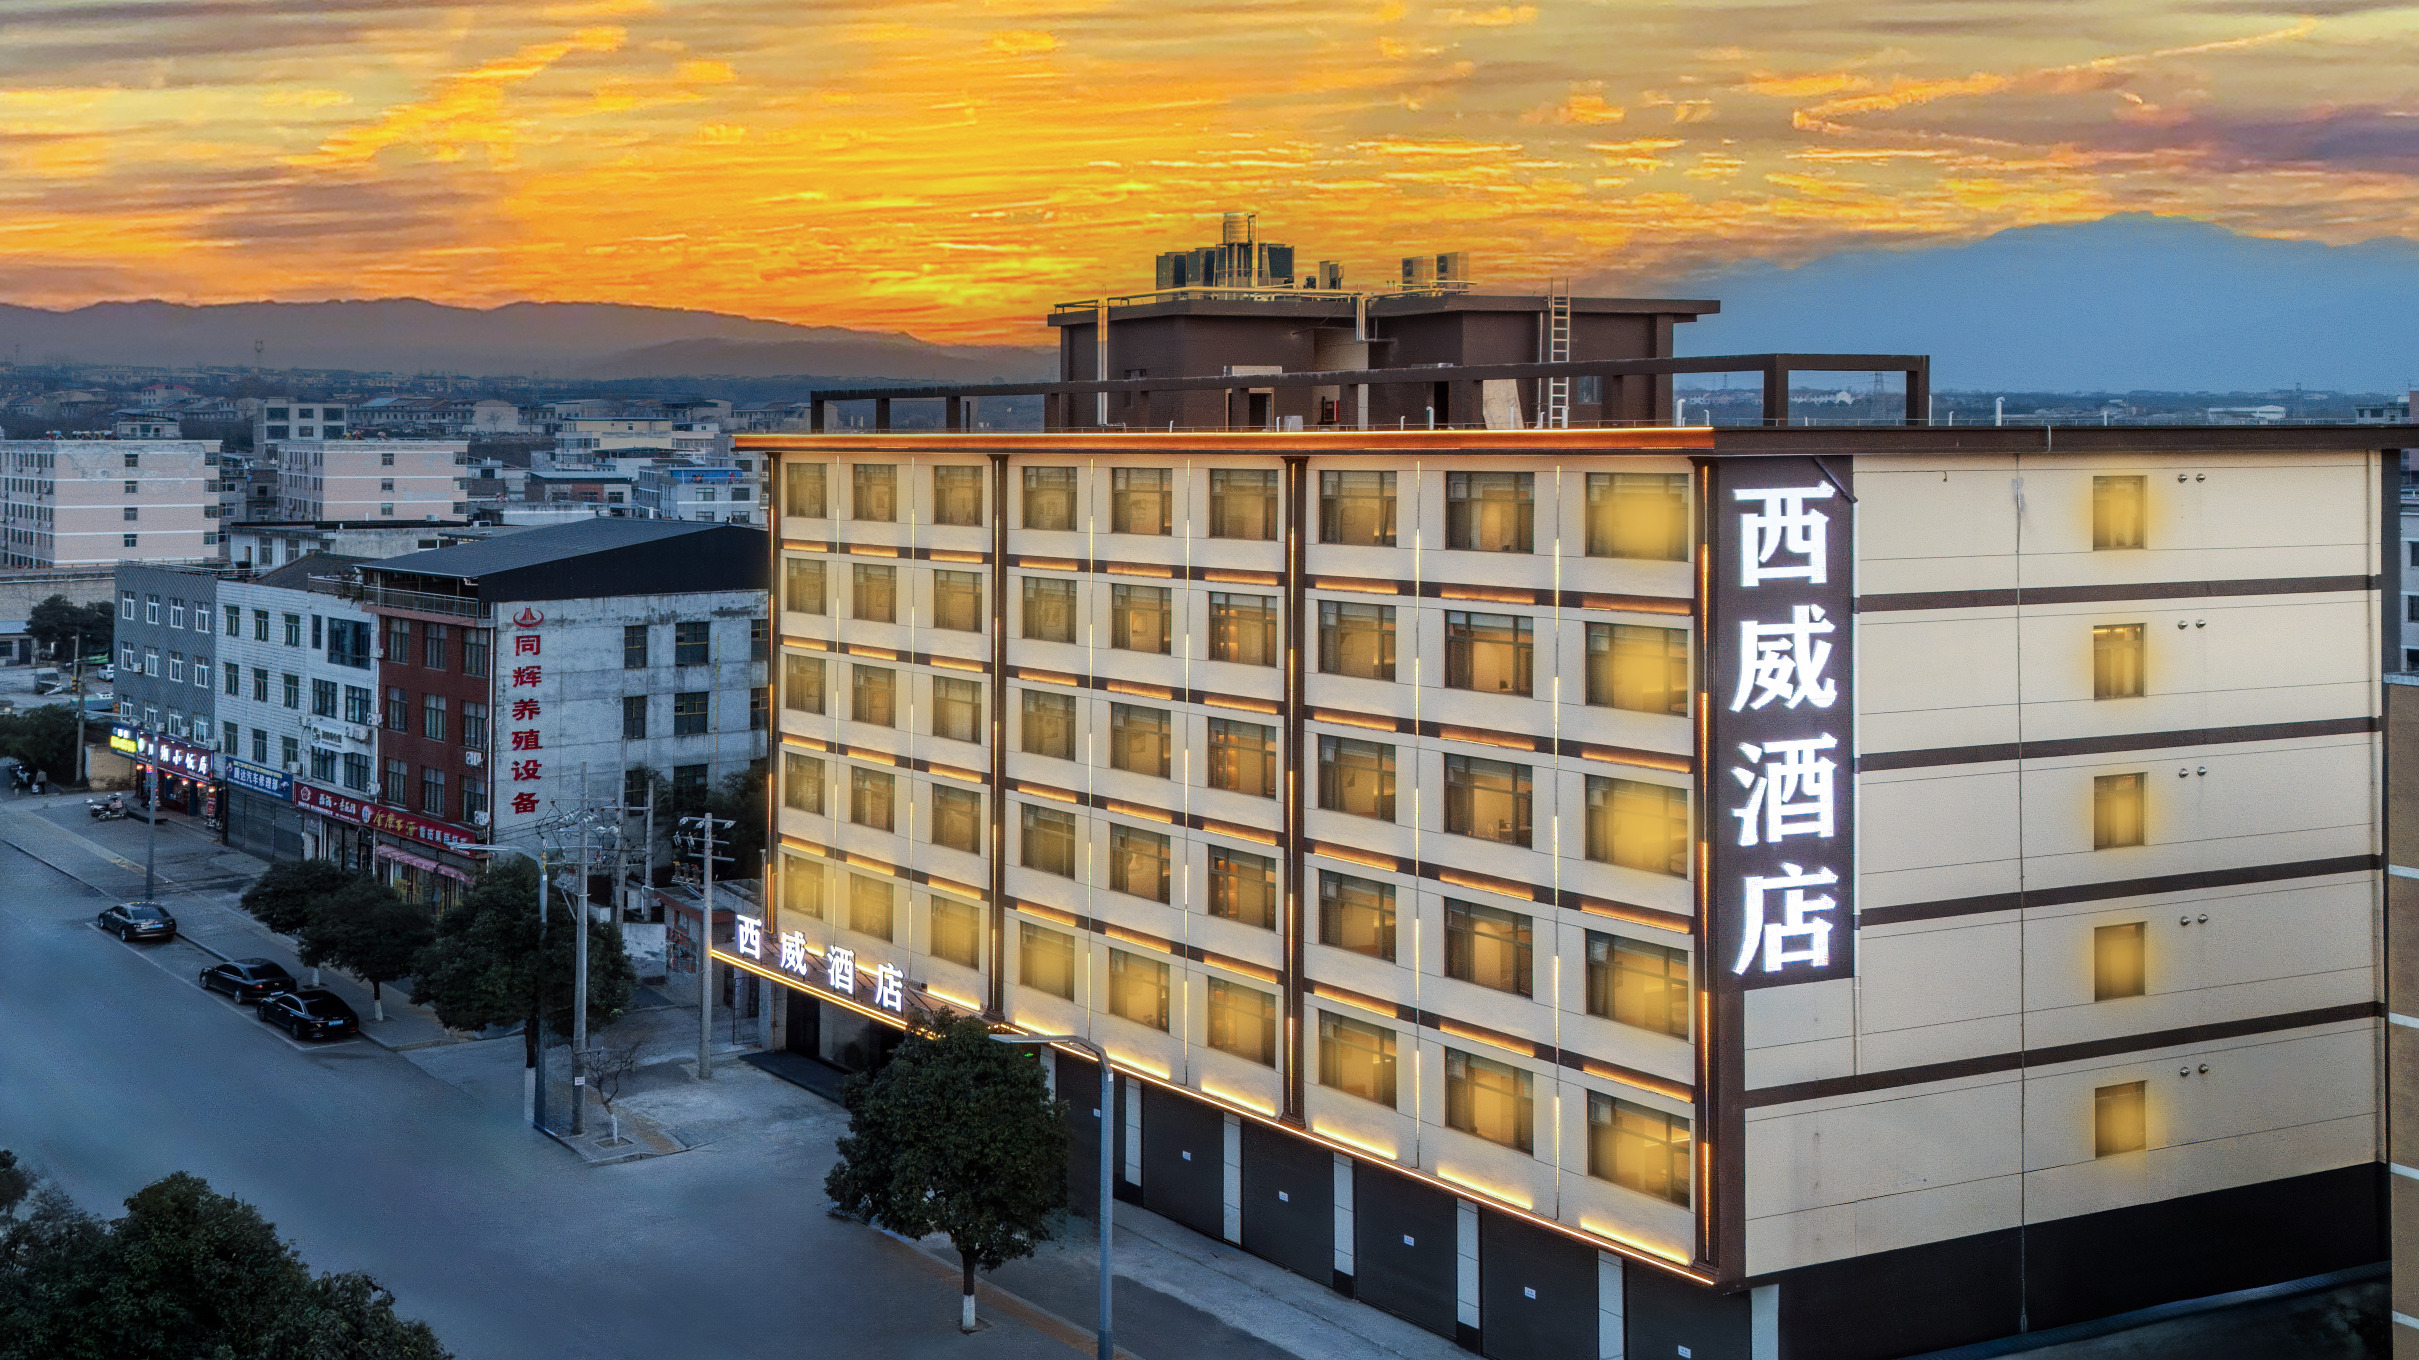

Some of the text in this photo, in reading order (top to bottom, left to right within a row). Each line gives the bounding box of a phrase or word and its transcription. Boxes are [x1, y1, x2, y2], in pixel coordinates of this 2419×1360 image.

[510, 634, 543, 815] 同辉养殖设备
[1730, 480, 1838, 976] 西威酒店
[737, 914, 904, 1012] 西威酒店
